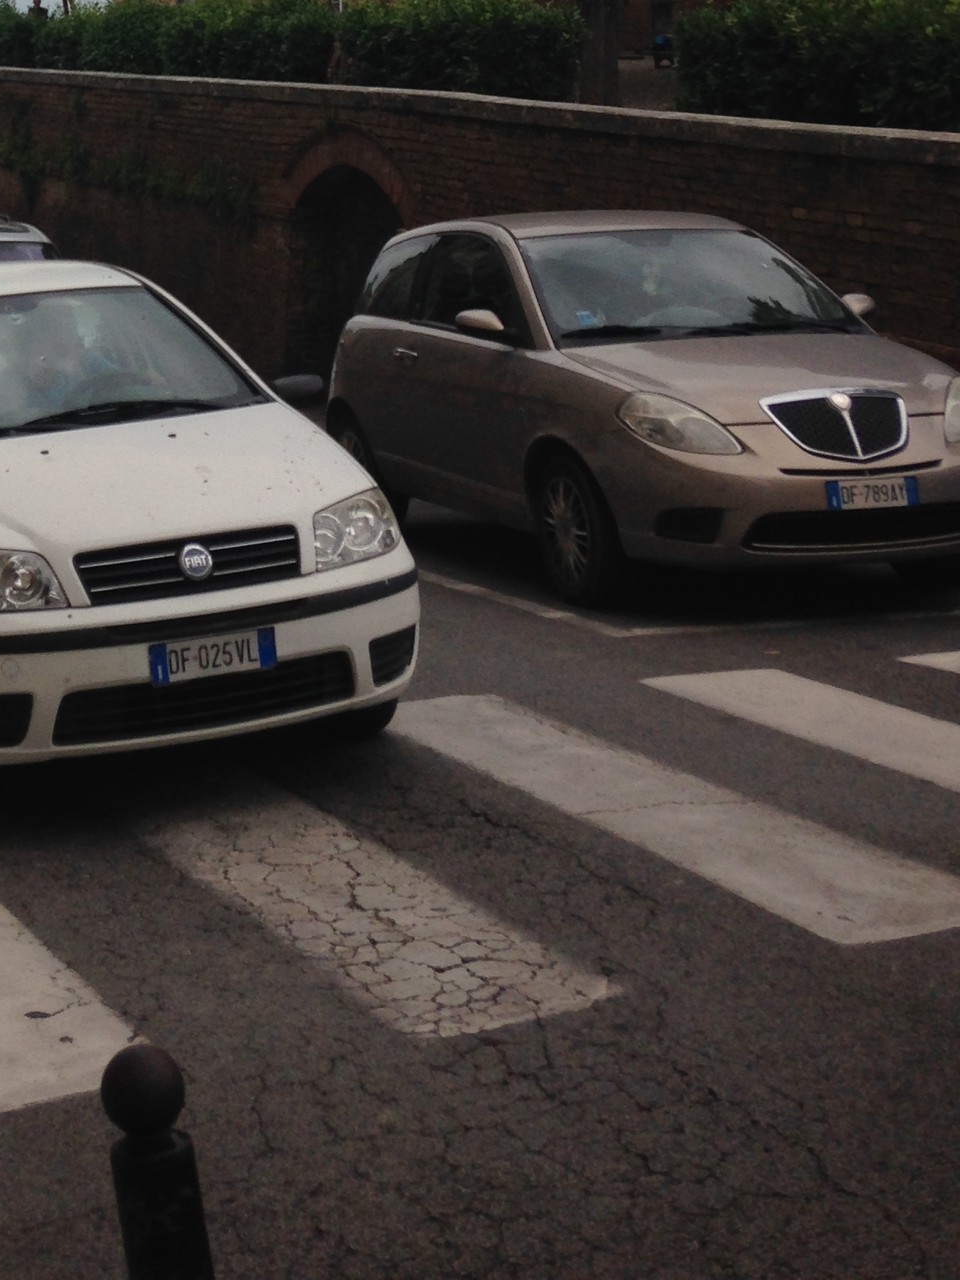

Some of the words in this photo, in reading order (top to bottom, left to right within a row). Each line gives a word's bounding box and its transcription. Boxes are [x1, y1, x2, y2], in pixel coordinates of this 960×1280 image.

[184, 555, 207, 569] FIAT
[169, 647, 191, 675] DF
[198, 638, 258, 670] 025VL
